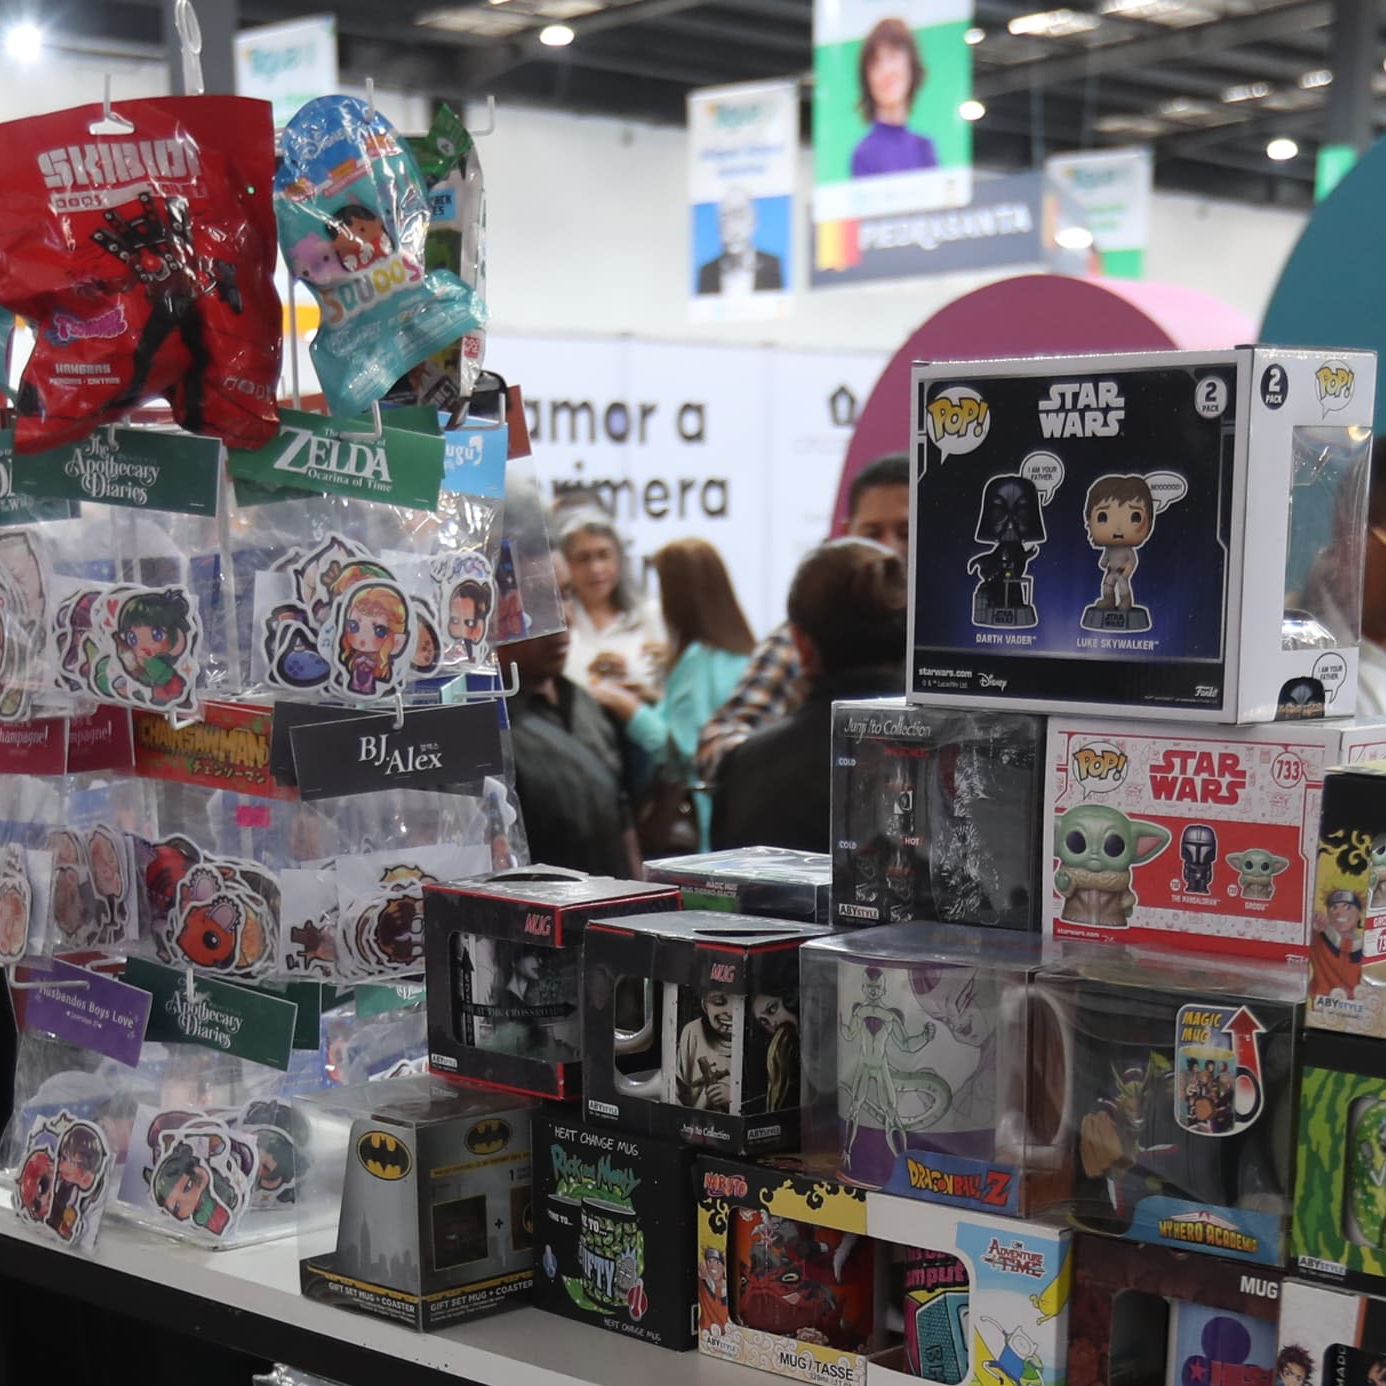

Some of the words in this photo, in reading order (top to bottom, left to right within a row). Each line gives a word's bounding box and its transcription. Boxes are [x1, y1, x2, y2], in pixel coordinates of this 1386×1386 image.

[1204, 382, 1217, 401] 2
[1268, 367, 1281, 391] 2
[1315, 367, 1355, 399] POP!
[1038, 382, 1125, 409] STAR
[1201, 402, 1221, 414] PACK
[1265, 393, 1283, 404] PACK
[677, 401, 706, 442] a
[927, 397, 990, 440] POP!
[1038, 408, 1125, 438] WARS
[65, 448, 160, 487] Apothecary
[274, 425, 393, 483] ZELDA
[81, 471, 148, 505] Diaries
[308, 469, 350, 487] Ocarina
[353, 476, 365, 487] of
[367, 478, 392, 493] Time
[976, 633, 1000, 645] DARTH
[1076, 638, 1098, 649] LUKE
[919, 668, 973, 680] starwars.com
[978, 673, 1007, 692] Disney
[385, 747, 443, 776] Alex
[1073, 747, 1128, 781] POP!
[1149, 749, 1246, 779] STAR
[1276, 758, 1302, 782] 733
[1149, 775, 1246, 805] WARS
[524, 912, 552, 936] MUG
[839, 905, 879, 919] ABYSTYLE
[712, 963, 734, 982] MUG
[88, 1001, 112, 1021] Boys
[112, 1006, 135, 1029] Love
[165, 991, 245, 1033] Apothecary
[1182, 1010, 1221, 1029] MAGIC
[178, 1013, 232, 1049] Diaries
[1181, 1027, 1208, 1042] MUG
[555, 1128, 578, 1141] HEAT
[580, 1133, 614, 1151] CHANGE
[617, 1142, 639, 1156] MUG
[704, 1172, 748, 1197] NARUTO
[907, 1159, 954, 1195] DRAGON
[984, 1171, 1014, 1207] Z
[1174, 1222, 1203, 1242] HERO
[1206, 1228, 1258, 1253] ACADEMIA
[989, 1240, 1043, 1266] ADVENTURE
[1240, 1275, 1279, 1299] MUG
[780, 1352, 808, 1370] MUG
[813, 1359, 854, 1381] TASSE
